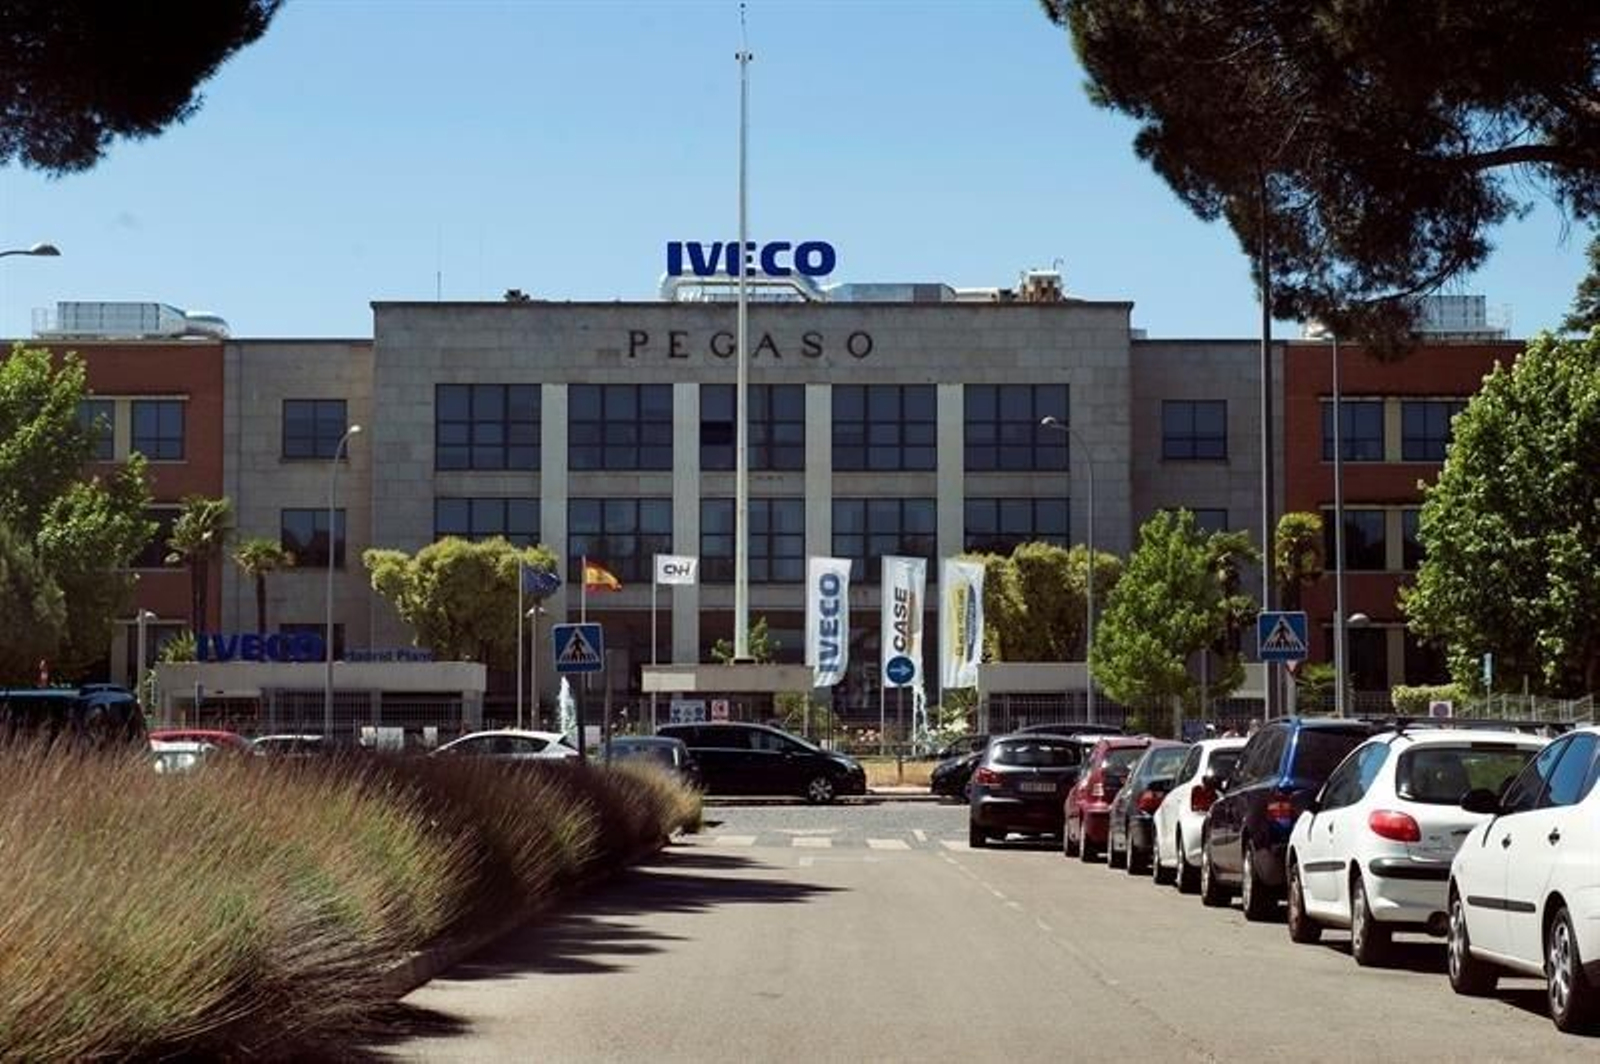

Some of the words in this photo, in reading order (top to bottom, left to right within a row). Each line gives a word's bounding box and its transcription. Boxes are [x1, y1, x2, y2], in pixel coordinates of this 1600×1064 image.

[667, 241, 836, 276] IVECO
[628, 331, 874, 358] PEGASO
[819, 573, 841, 672] IVECO
[893, 587, 909, 652] CASE
[198, 632, 324, 662] IVECO
